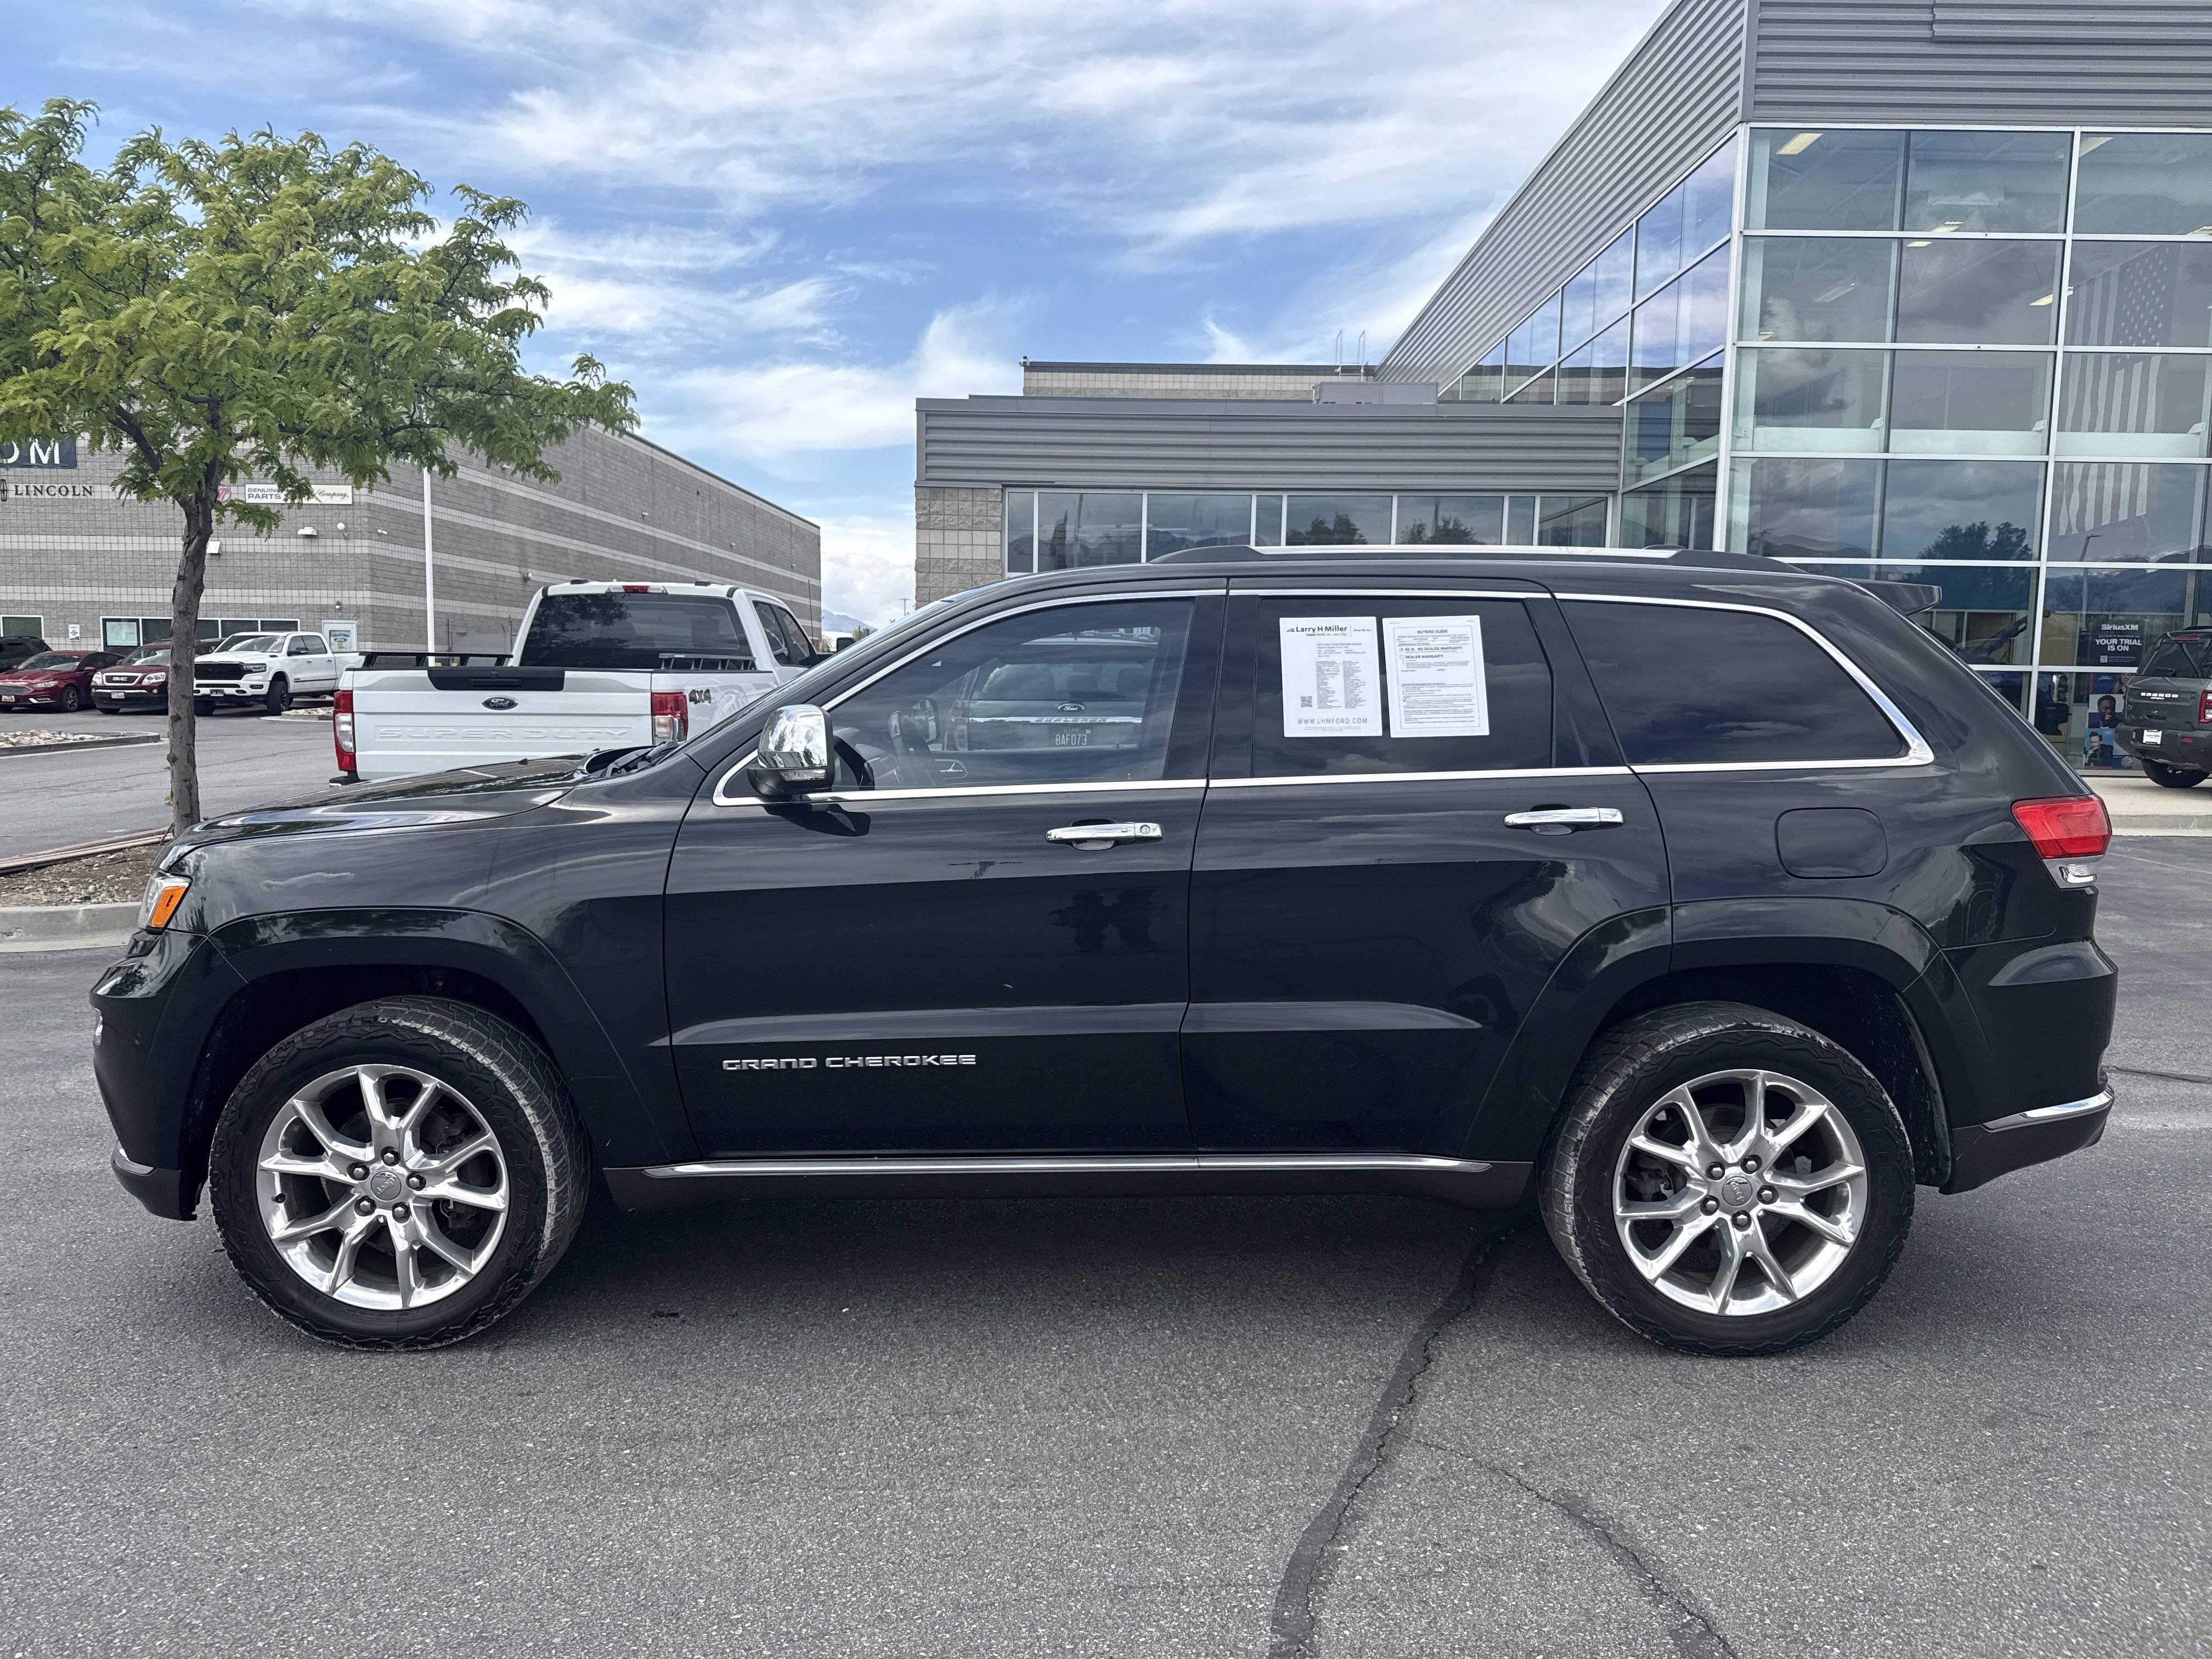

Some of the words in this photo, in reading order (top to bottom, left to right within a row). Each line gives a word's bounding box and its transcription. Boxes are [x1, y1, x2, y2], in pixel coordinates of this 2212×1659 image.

[14, 485, 93, 496] LINCOLN
[489, 698, 509, 708] Ford
[380, 727, 512, 739] SUPER
[524, 728, 628, 740] DUTY
[723, 1058, 817, 1070] GRAND
[825, 1054, 977, 1068] CHEROKEE
[376, 1177, 395, 1194] Jeep
[1730, 1182, 1745, 1202] Jeep
